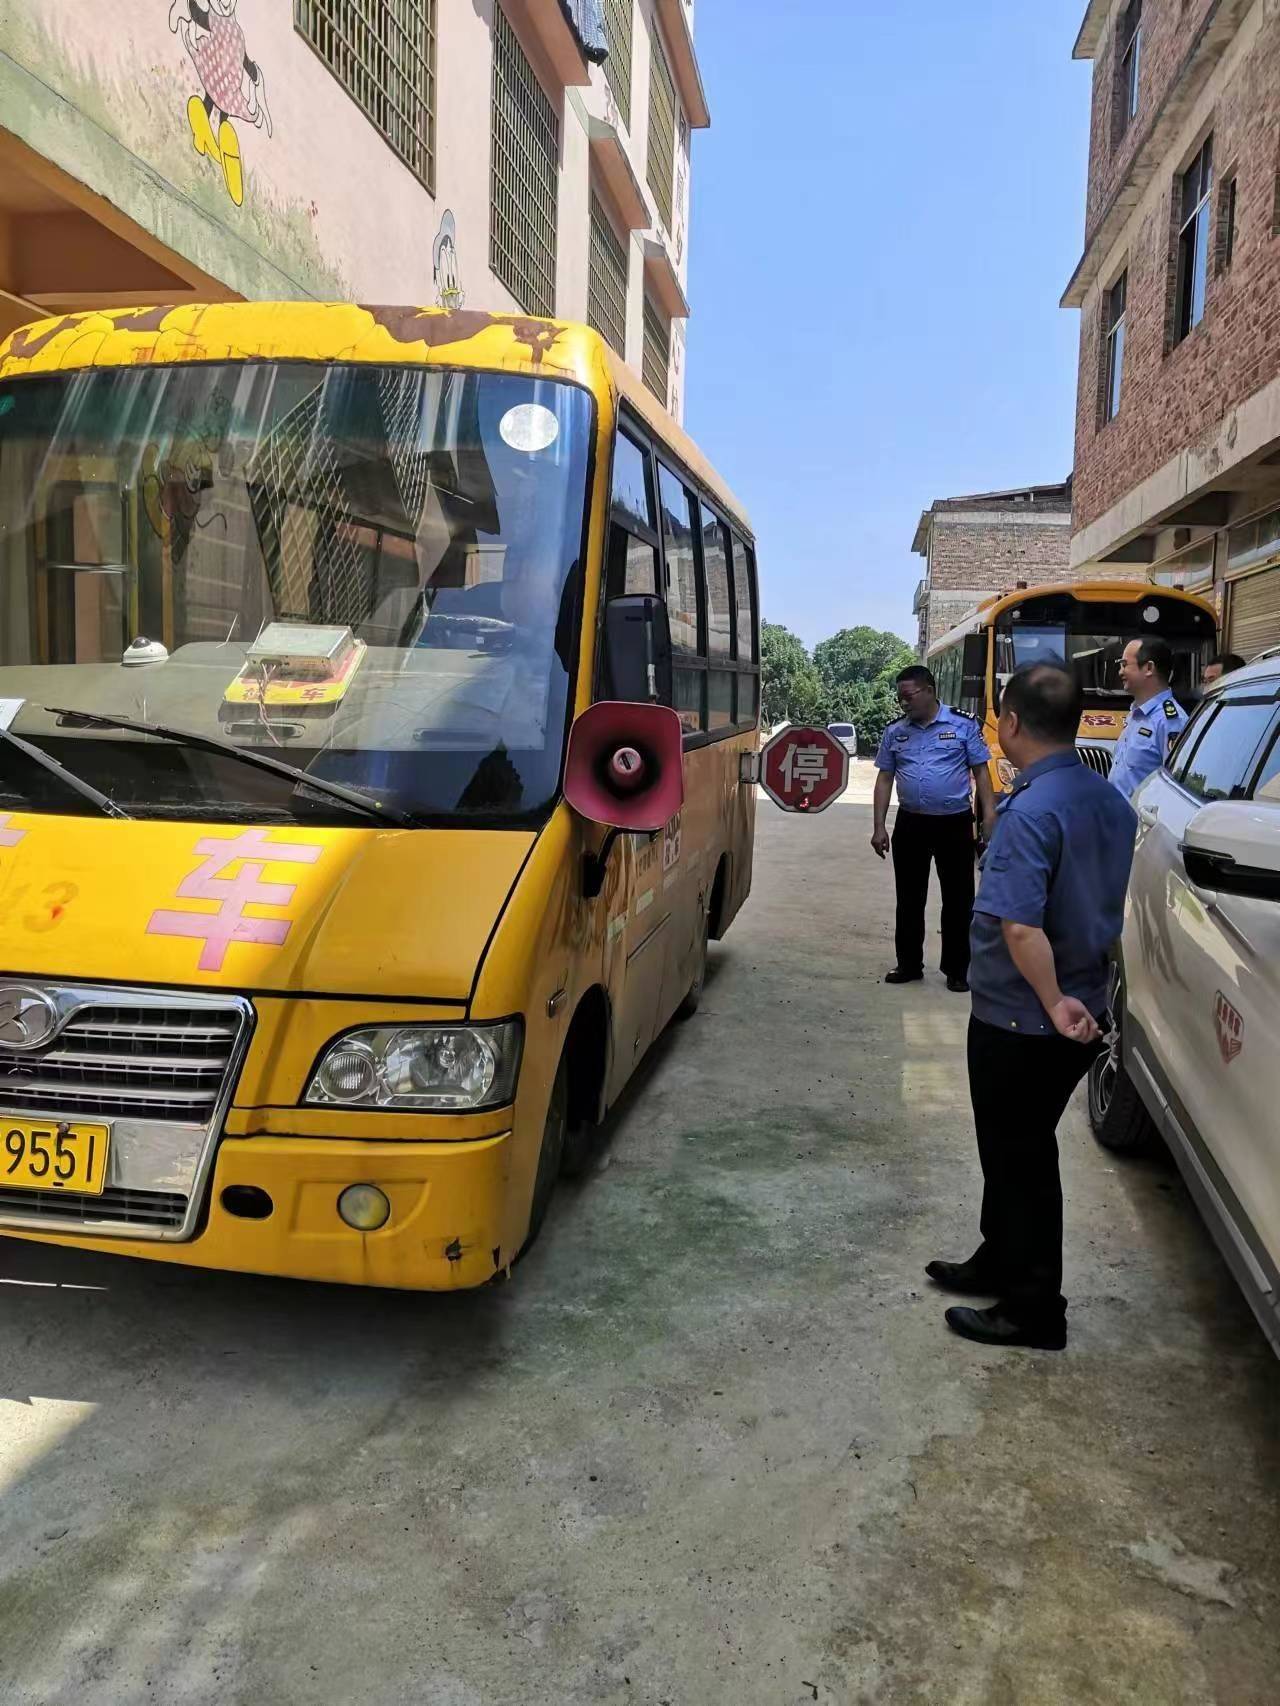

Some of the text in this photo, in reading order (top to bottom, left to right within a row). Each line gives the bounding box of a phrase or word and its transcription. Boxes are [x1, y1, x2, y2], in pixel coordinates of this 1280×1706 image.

[1081, 714, 1127, 728] 校
[779, 743, 829, 793] 停
[145, 829, 323, 971] 车
[5, 1129, 95, 1183] 9551
